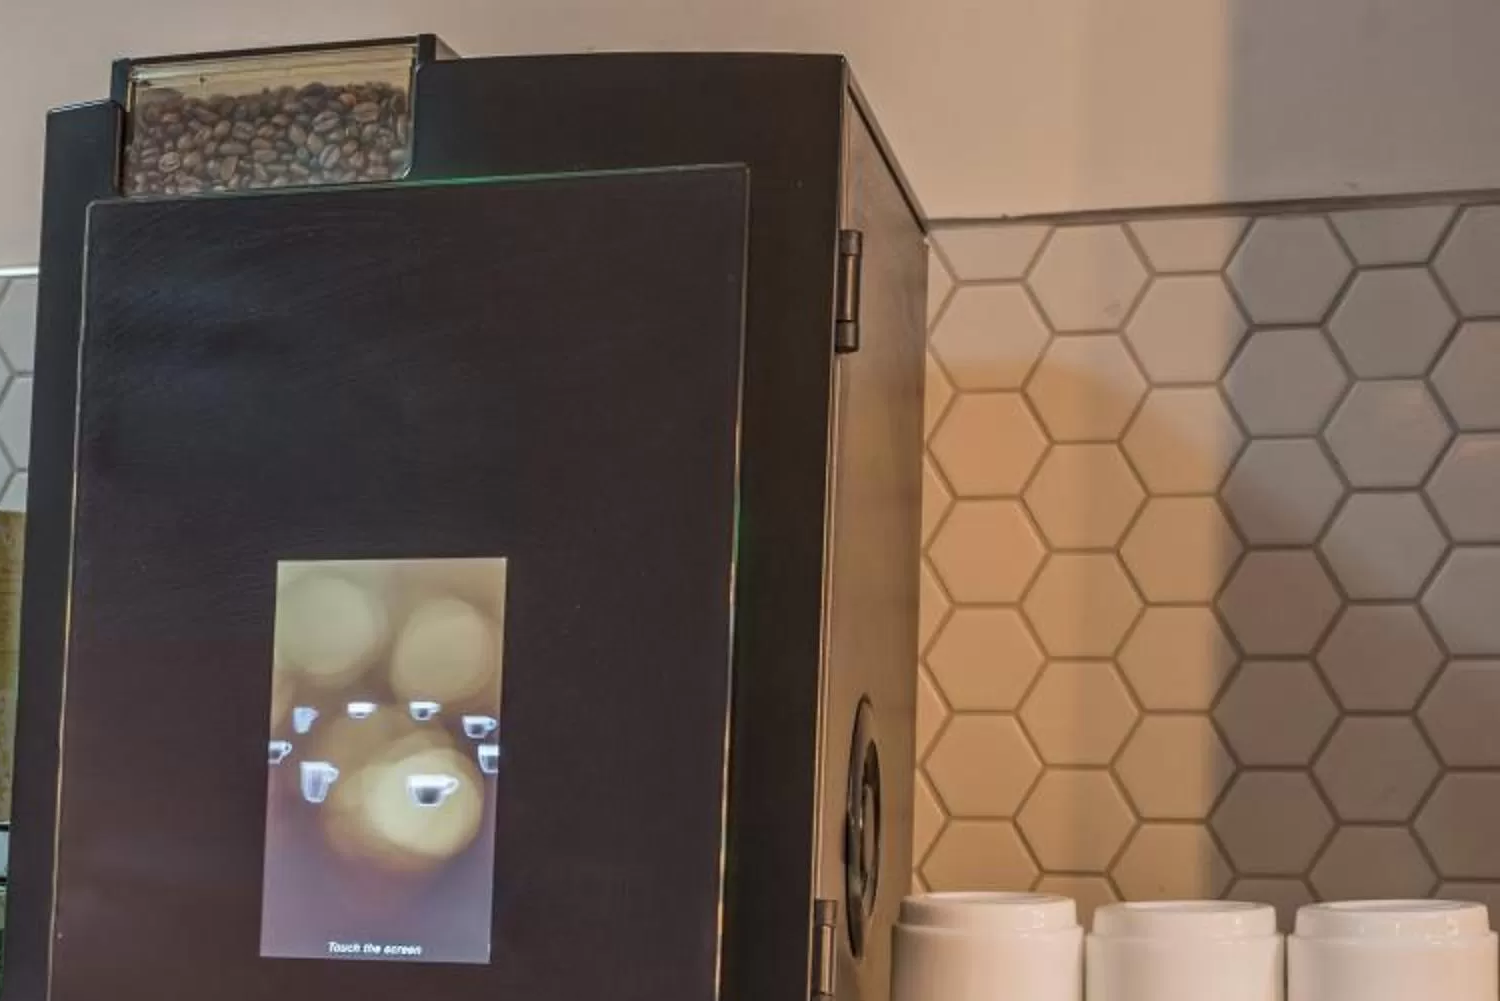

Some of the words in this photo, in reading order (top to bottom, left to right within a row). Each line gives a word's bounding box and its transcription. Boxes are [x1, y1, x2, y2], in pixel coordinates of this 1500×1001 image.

[328, 941, 360, 953] Touch
[363, 942, 381, 954] the
[383, 945, 422, 955] screen
